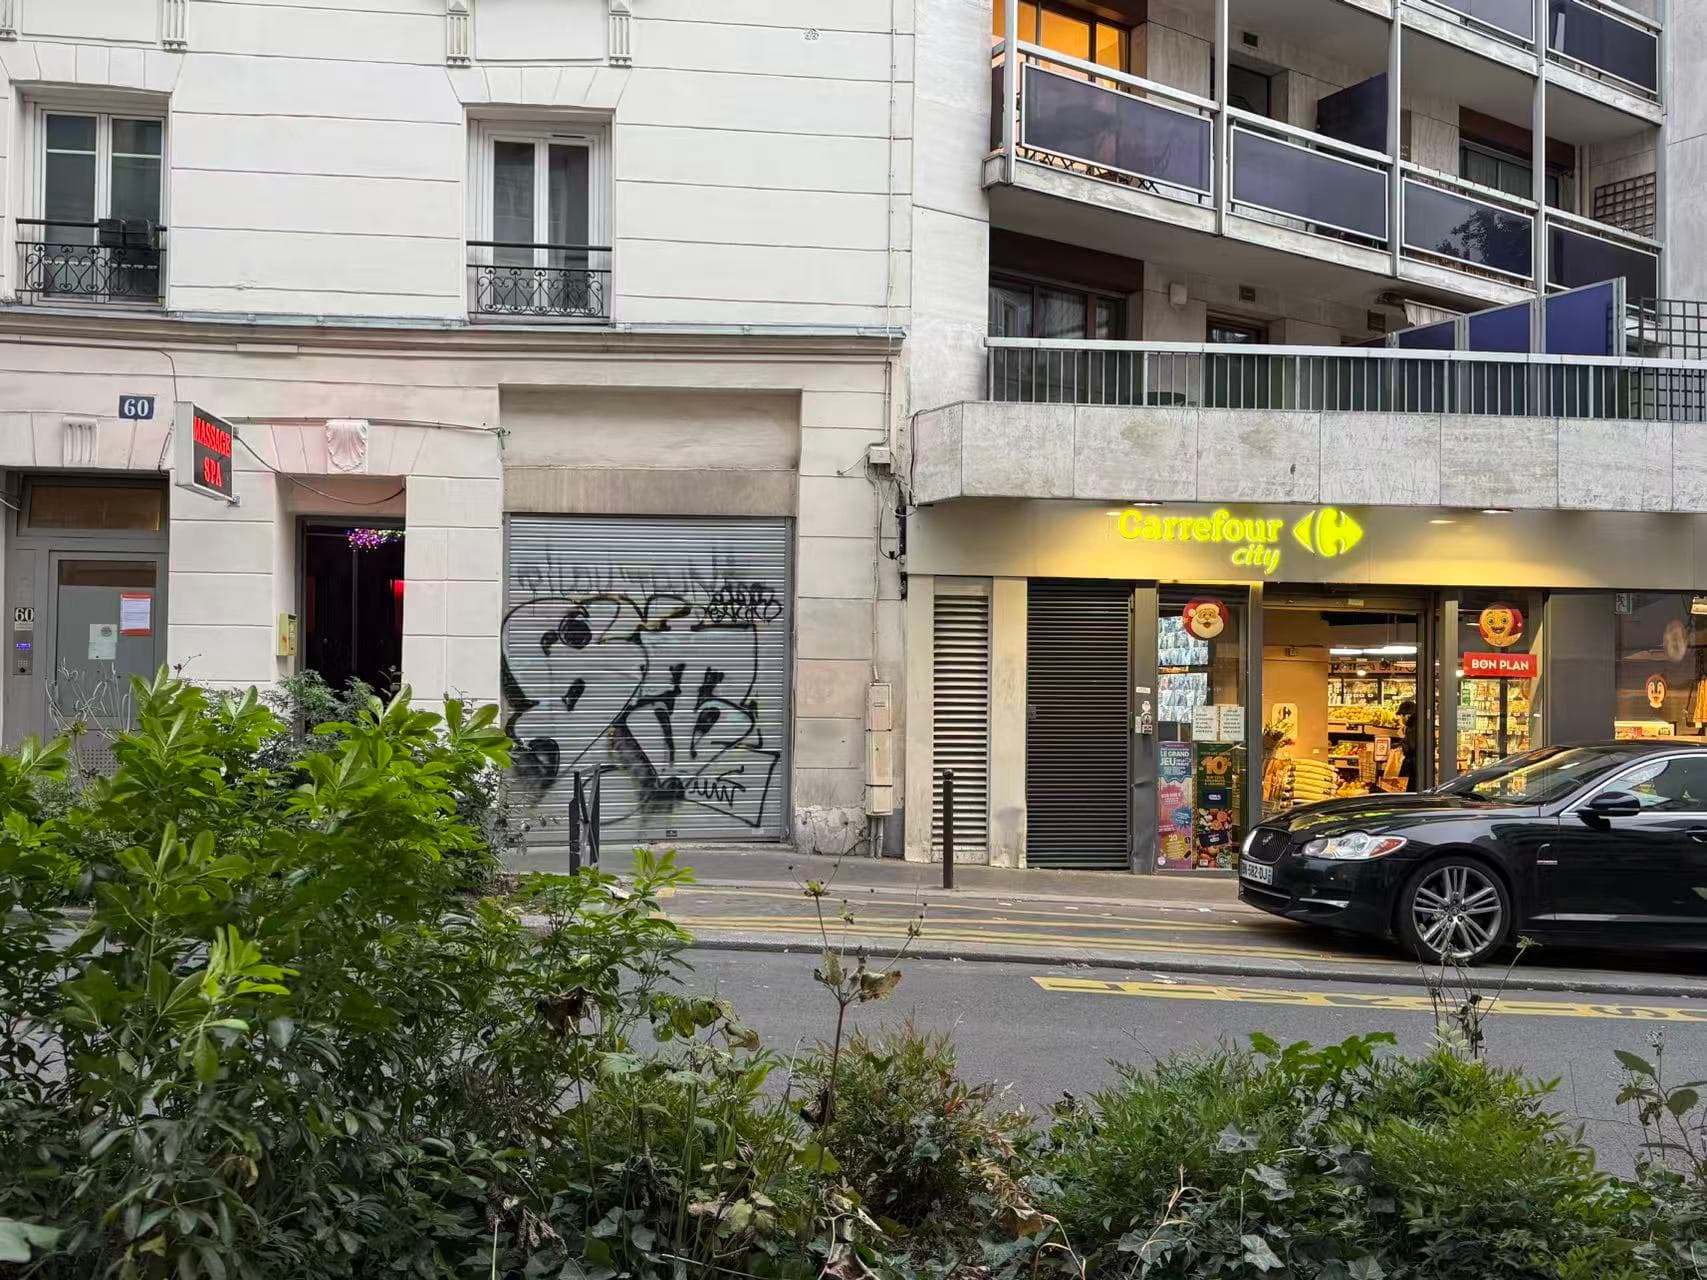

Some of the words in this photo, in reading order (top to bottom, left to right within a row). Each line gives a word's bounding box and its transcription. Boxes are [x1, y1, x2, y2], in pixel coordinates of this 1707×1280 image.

[123, 399, 149, 417] 60
[193, 415, 232, 458] MASSAGE
[203, 456, 223, 488] SPA
[1118, 508, 1283, 543] Carrefour
[1231, 543, 1280, 575] city
[15, 607, 34, 621] 60
[1471, 659, 1497, 670] BON
[1500, 660, 1529, 671] PLAN
